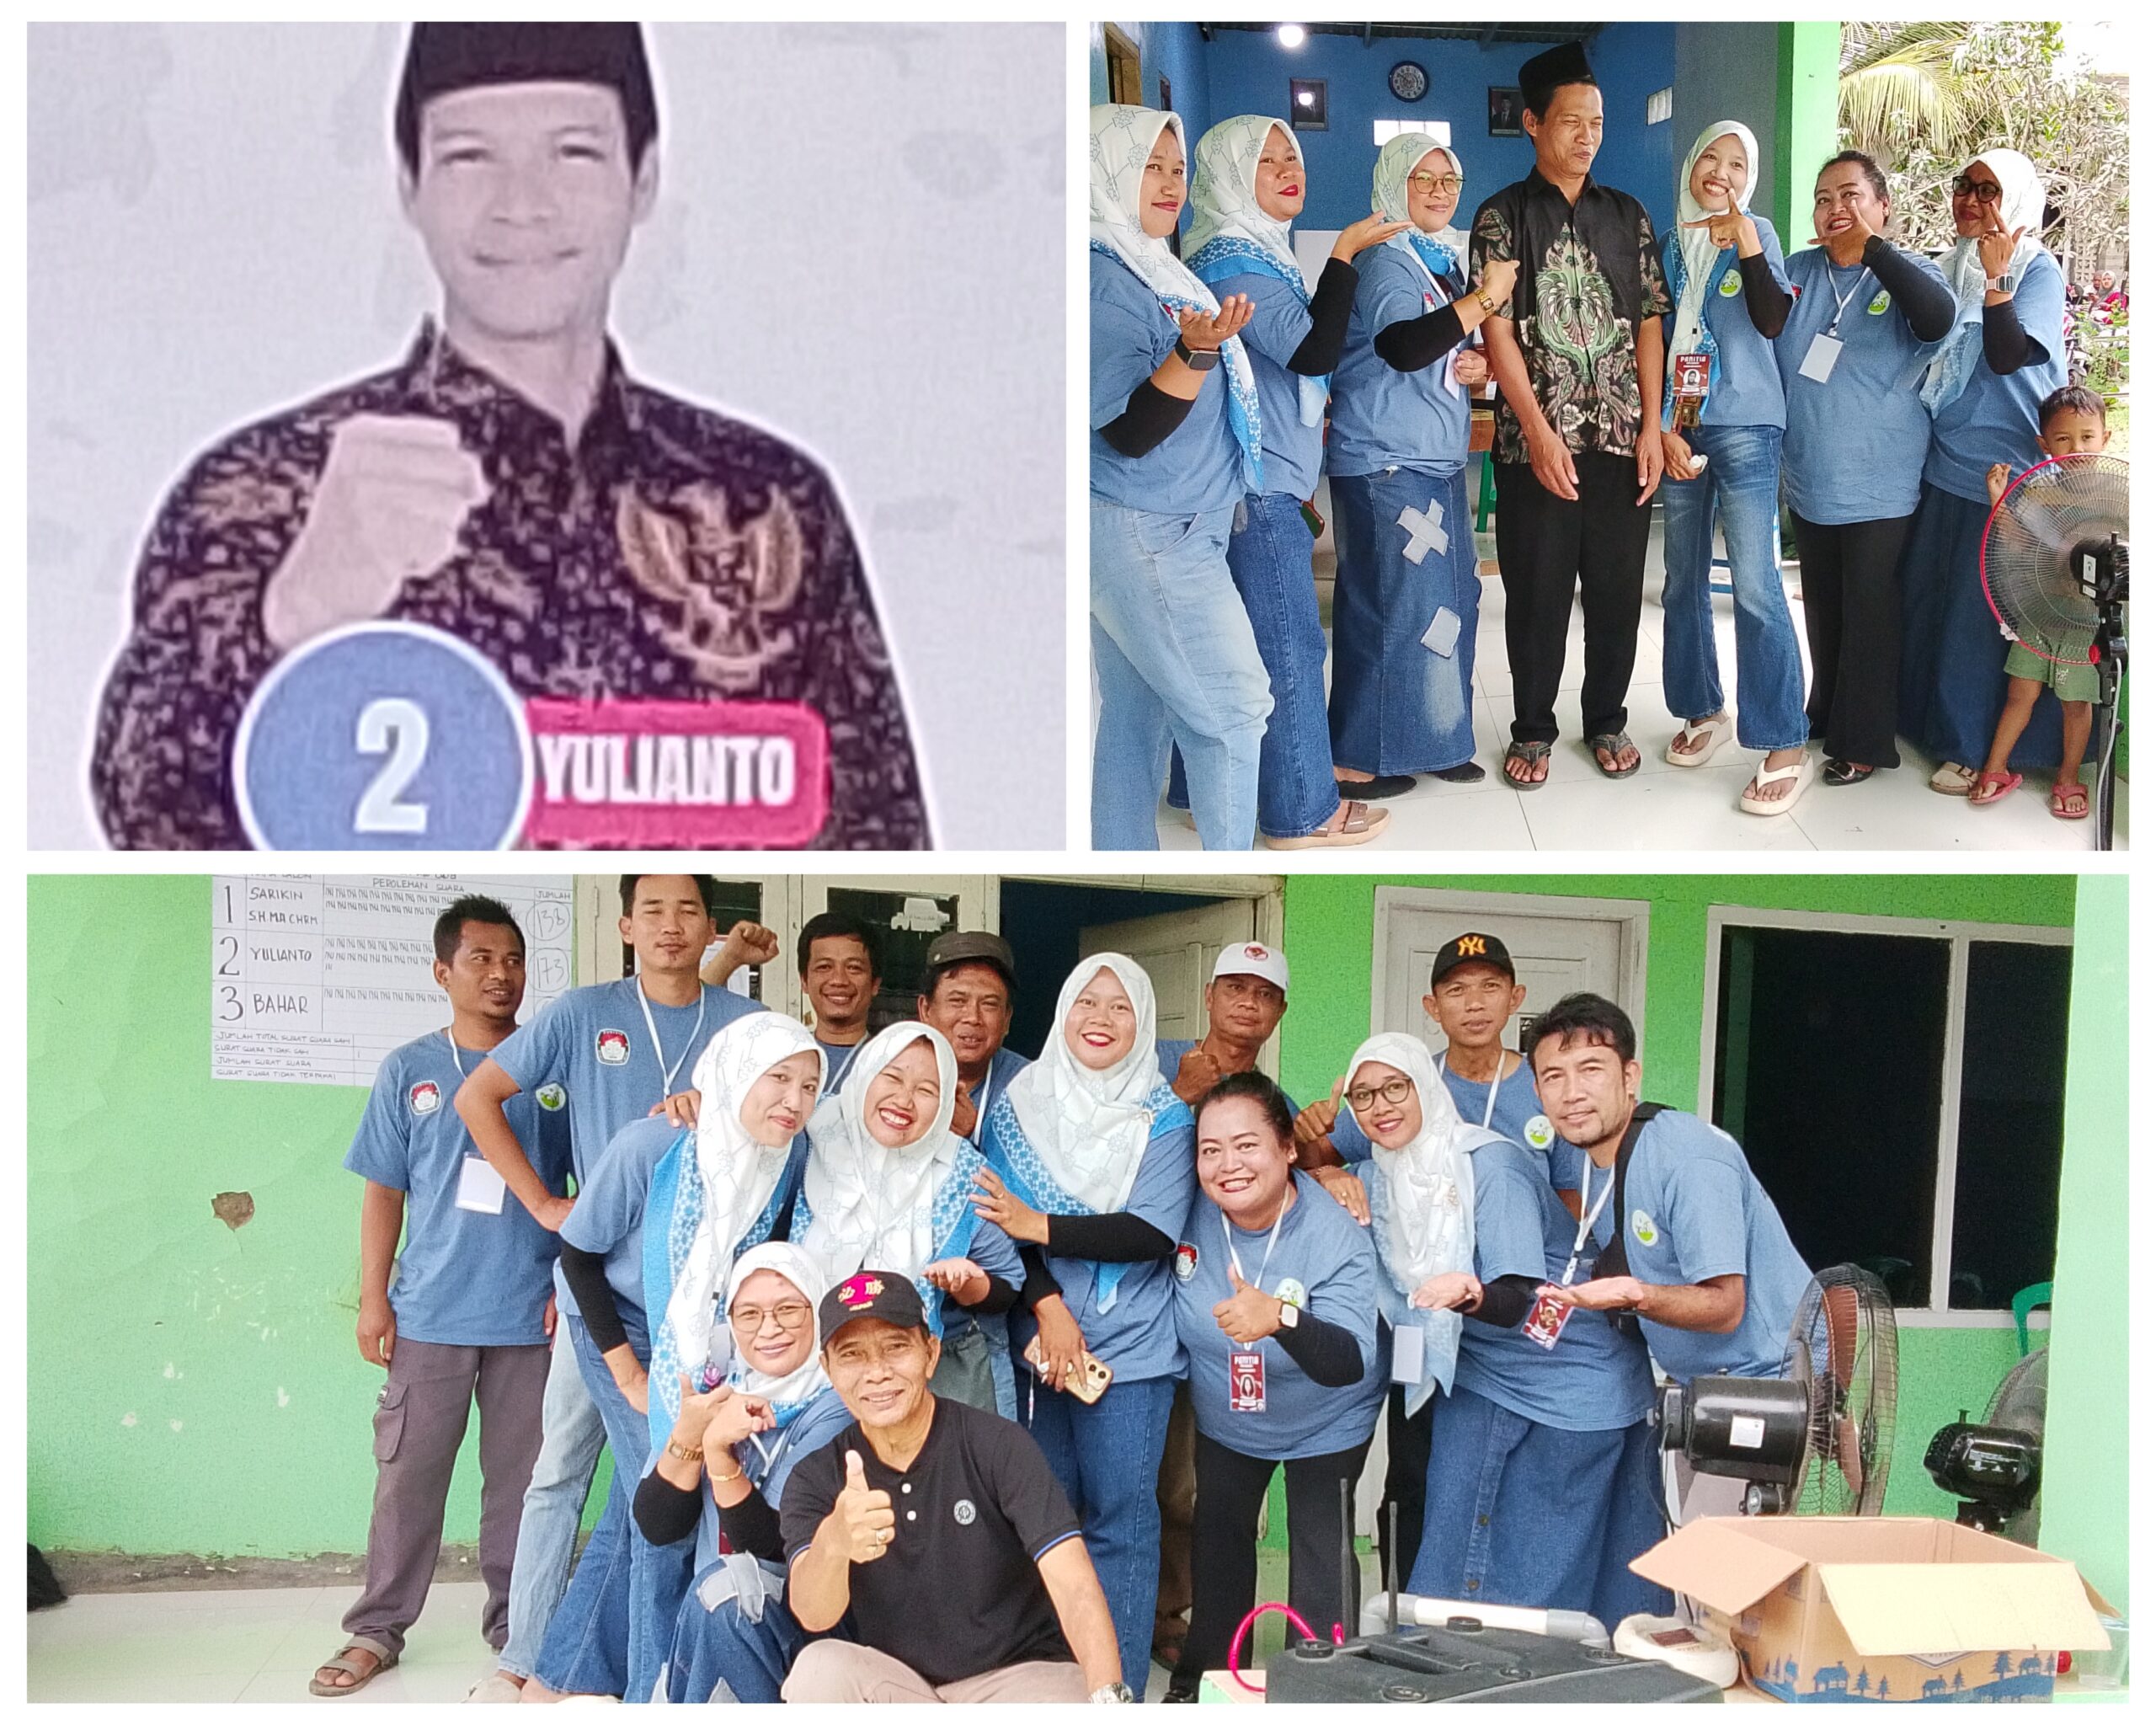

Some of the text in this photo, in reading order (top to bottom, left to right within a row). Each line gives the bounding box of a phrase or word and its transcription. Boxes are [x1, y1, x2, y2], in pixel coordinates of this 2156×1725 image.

[354, 697, 429, 833] 2
[538, 734, 795, 805] YULIANTO
[224, 885, 233, 923] 1
[249, 887, 303, 900] SARIKIN
[436, 884, 465, 893] SUARA
[536, 890, 571, 899] JUMLAH
[218, 936, 240, 975] 2
[250, 948, 312, 962] YULIANTO
[537, 957, 564, 989] 173
[219, 986, 243, 1021] 3
[253, 993, 308, 1014] BAHAR
